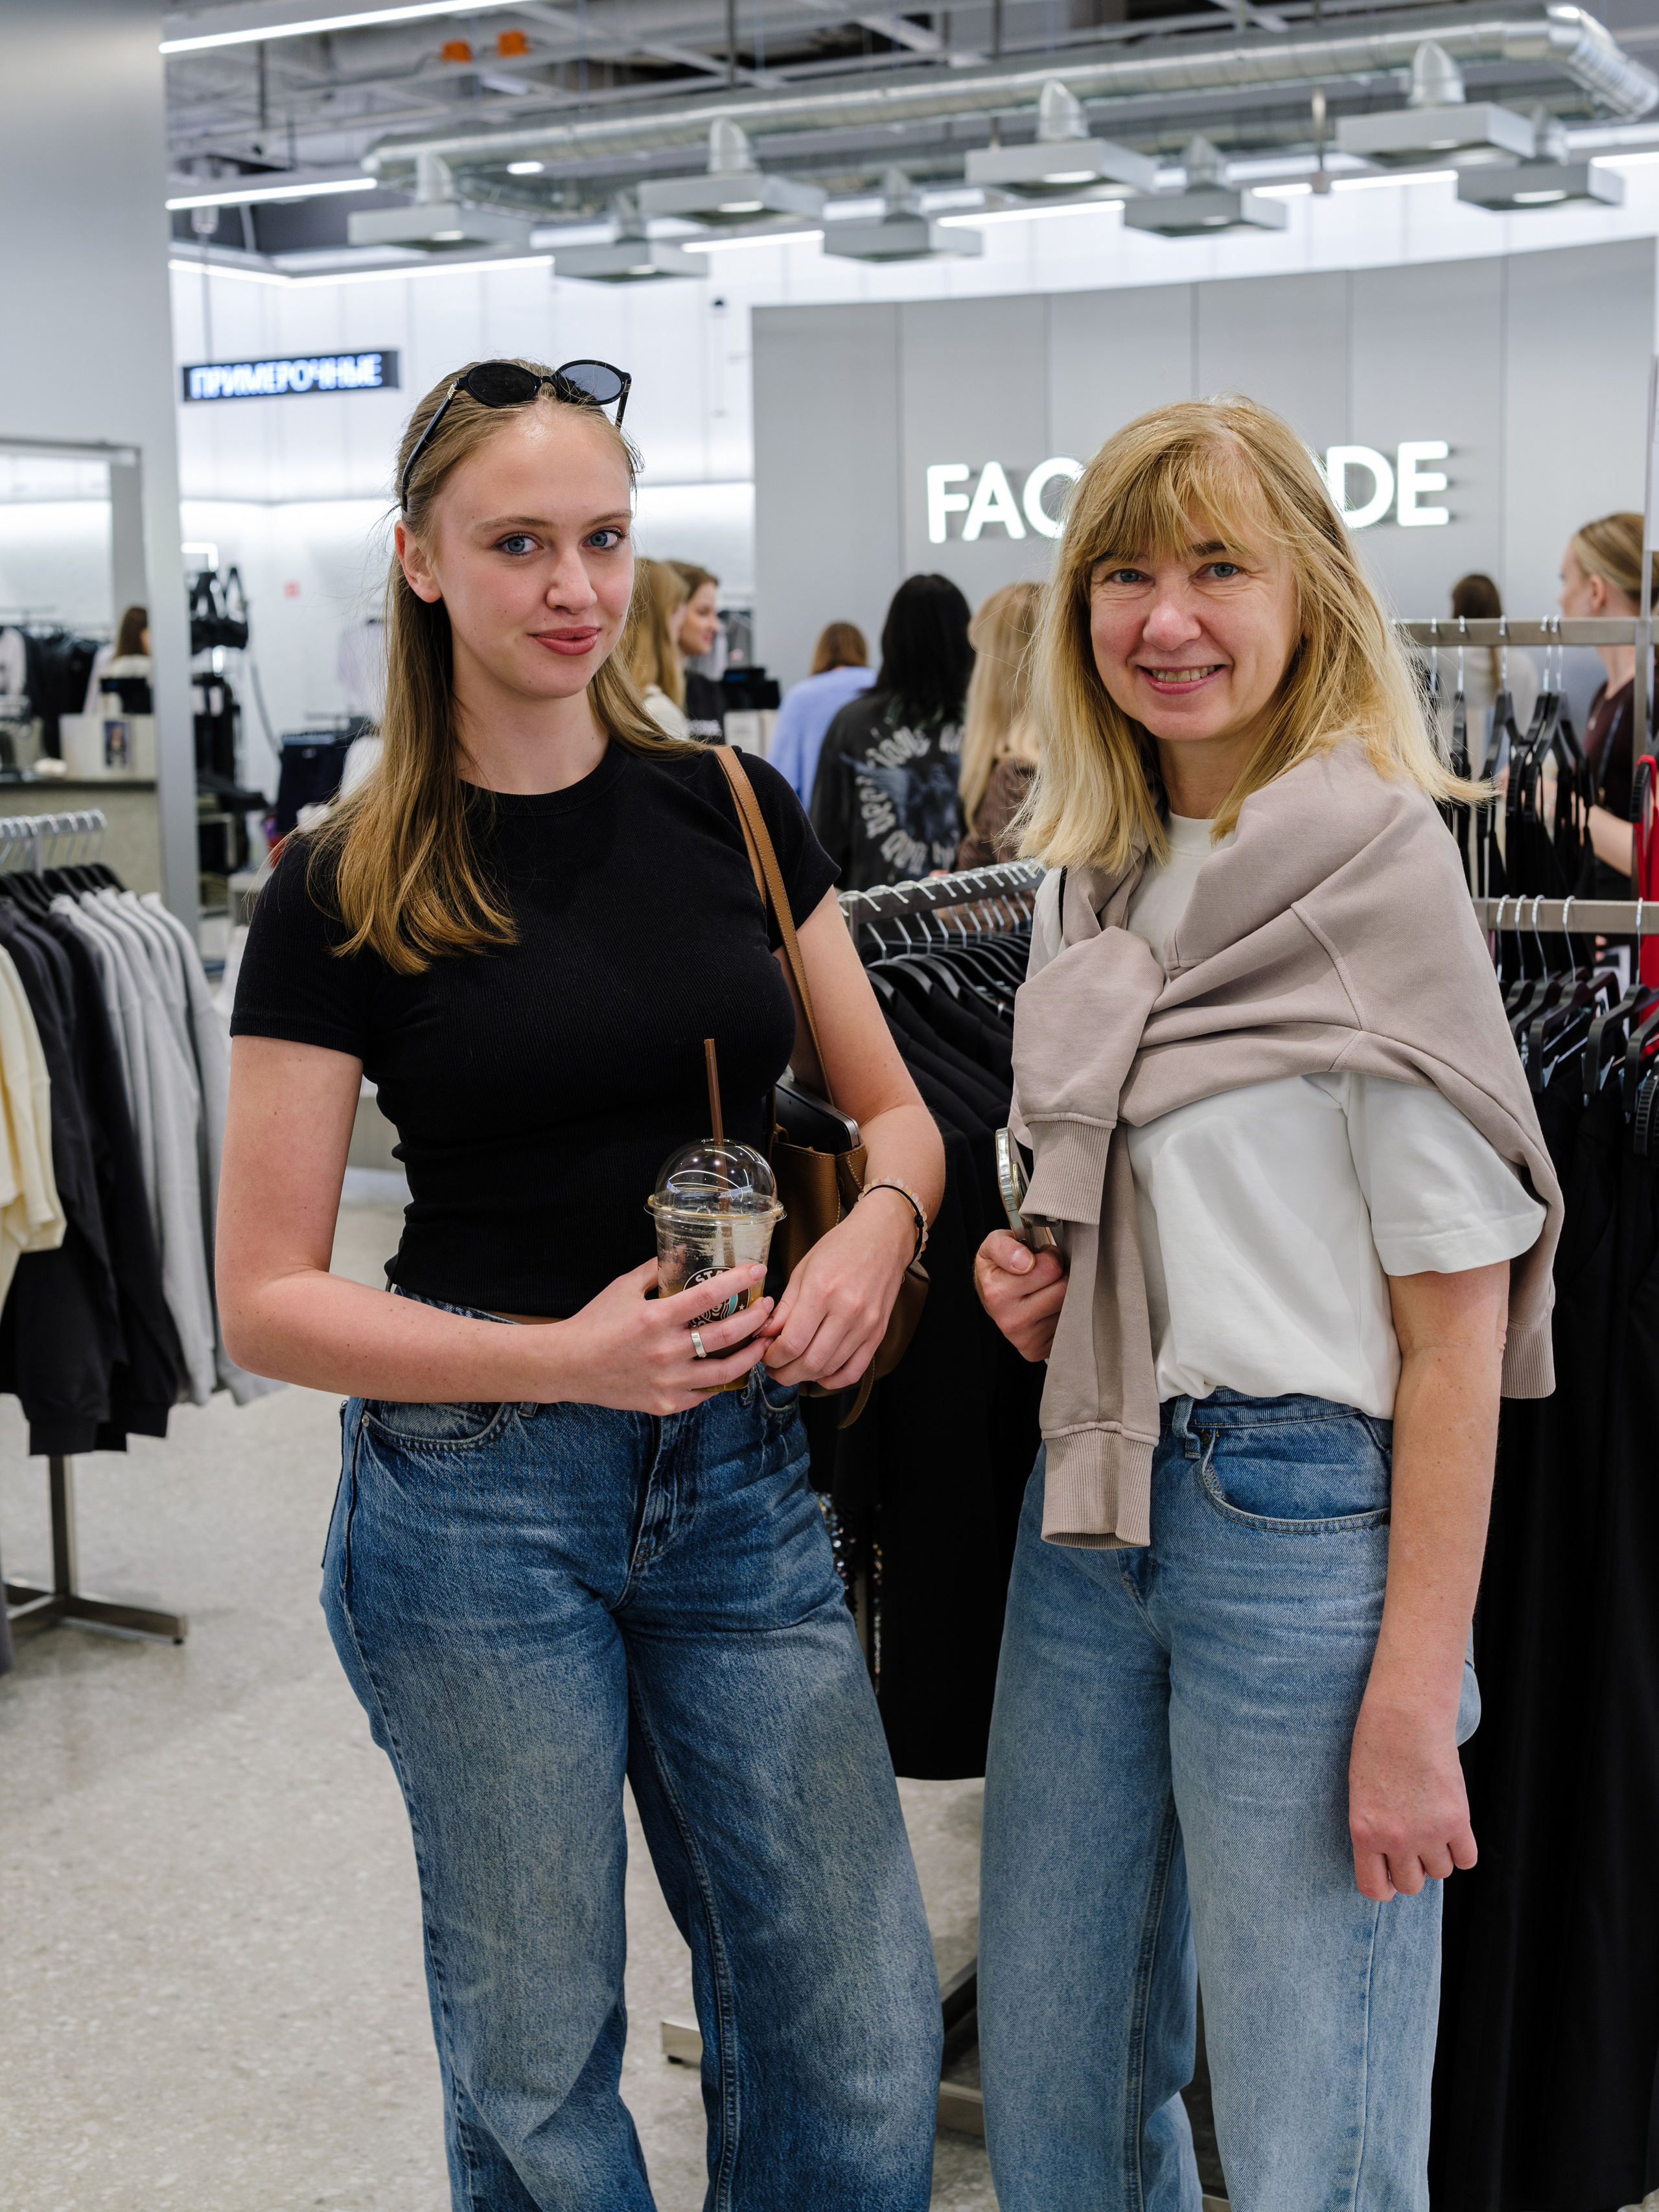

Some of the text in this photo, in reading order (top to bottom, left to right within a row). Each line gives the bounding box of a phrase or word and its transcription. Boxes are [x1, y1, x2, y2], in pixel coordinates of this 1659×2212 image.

[190, 353, 382, 399] ПРИМЕРОЧНЫЕ
[927, 440, 1449, 544] FAC DE
